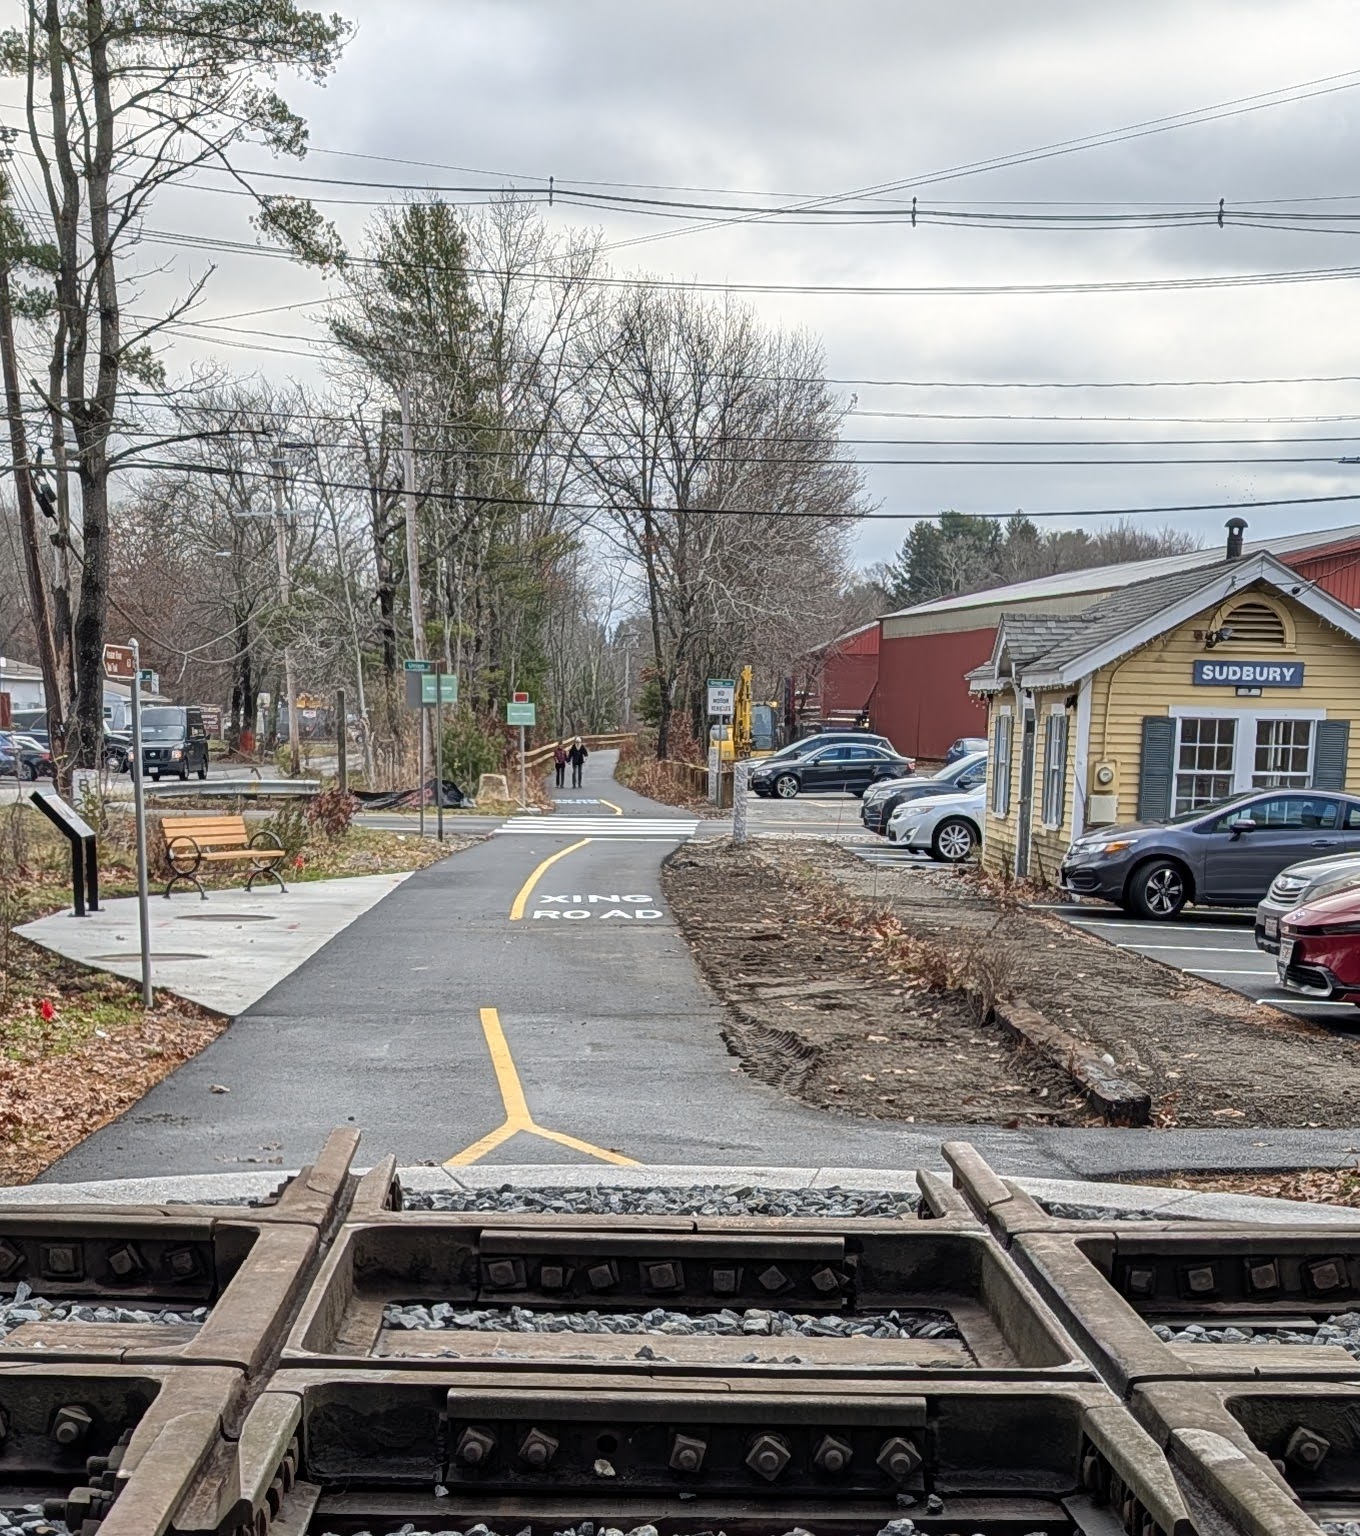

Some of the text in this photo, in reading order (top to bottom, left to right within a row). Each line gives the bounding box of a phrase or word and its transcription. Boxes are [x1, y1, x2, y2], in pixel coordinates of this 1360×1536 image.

[1201, 664, 1295, 682] SUDBURY
[539, 894, 653, 903] XING
[533, 909, 664, 919] ROAD
